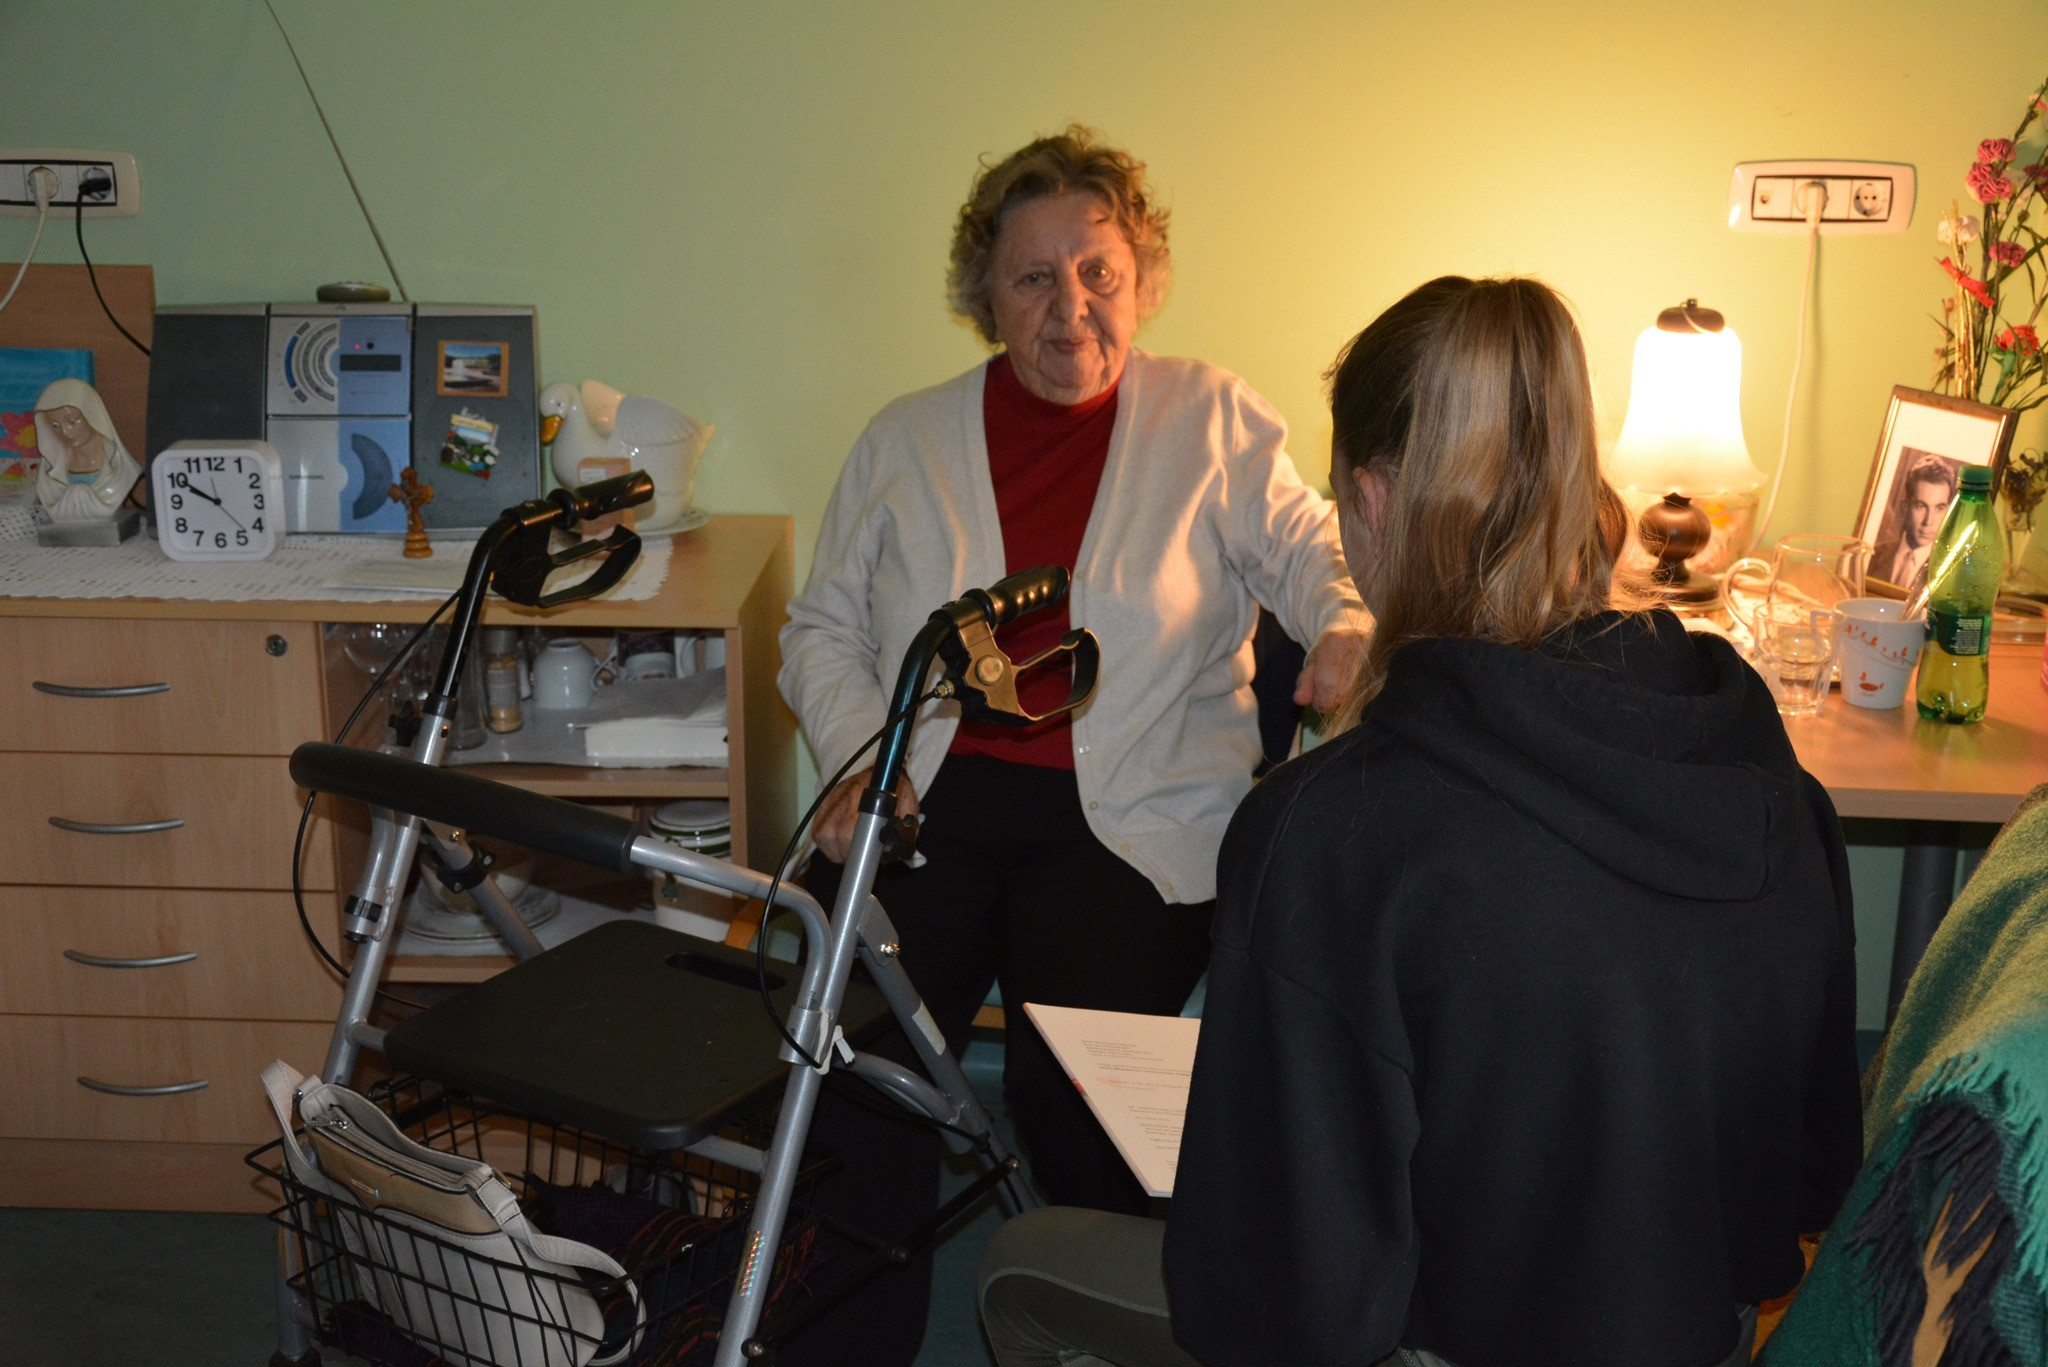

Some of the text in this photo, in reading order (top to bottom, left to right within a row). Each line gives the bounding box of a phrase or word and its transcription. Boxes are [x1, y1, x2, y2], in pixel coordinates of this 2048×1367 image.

[183, 457, 201, 474] 11
[203, 457, 226, 472] 12
[233, 457, 243, 474] 1
[167, 472, 189, 489] 10
[248, 472, 261, 489] 2
[170, 494, 183, 510] 9
[253, 494, 265, 510] 3
[175, 517, 188, 534] 8
[251, 517, 264, 533] 4
[193, 530, 205, 547] 7
[214, 532, 227, 548] 6
[236, 530, 249, 546] 5
